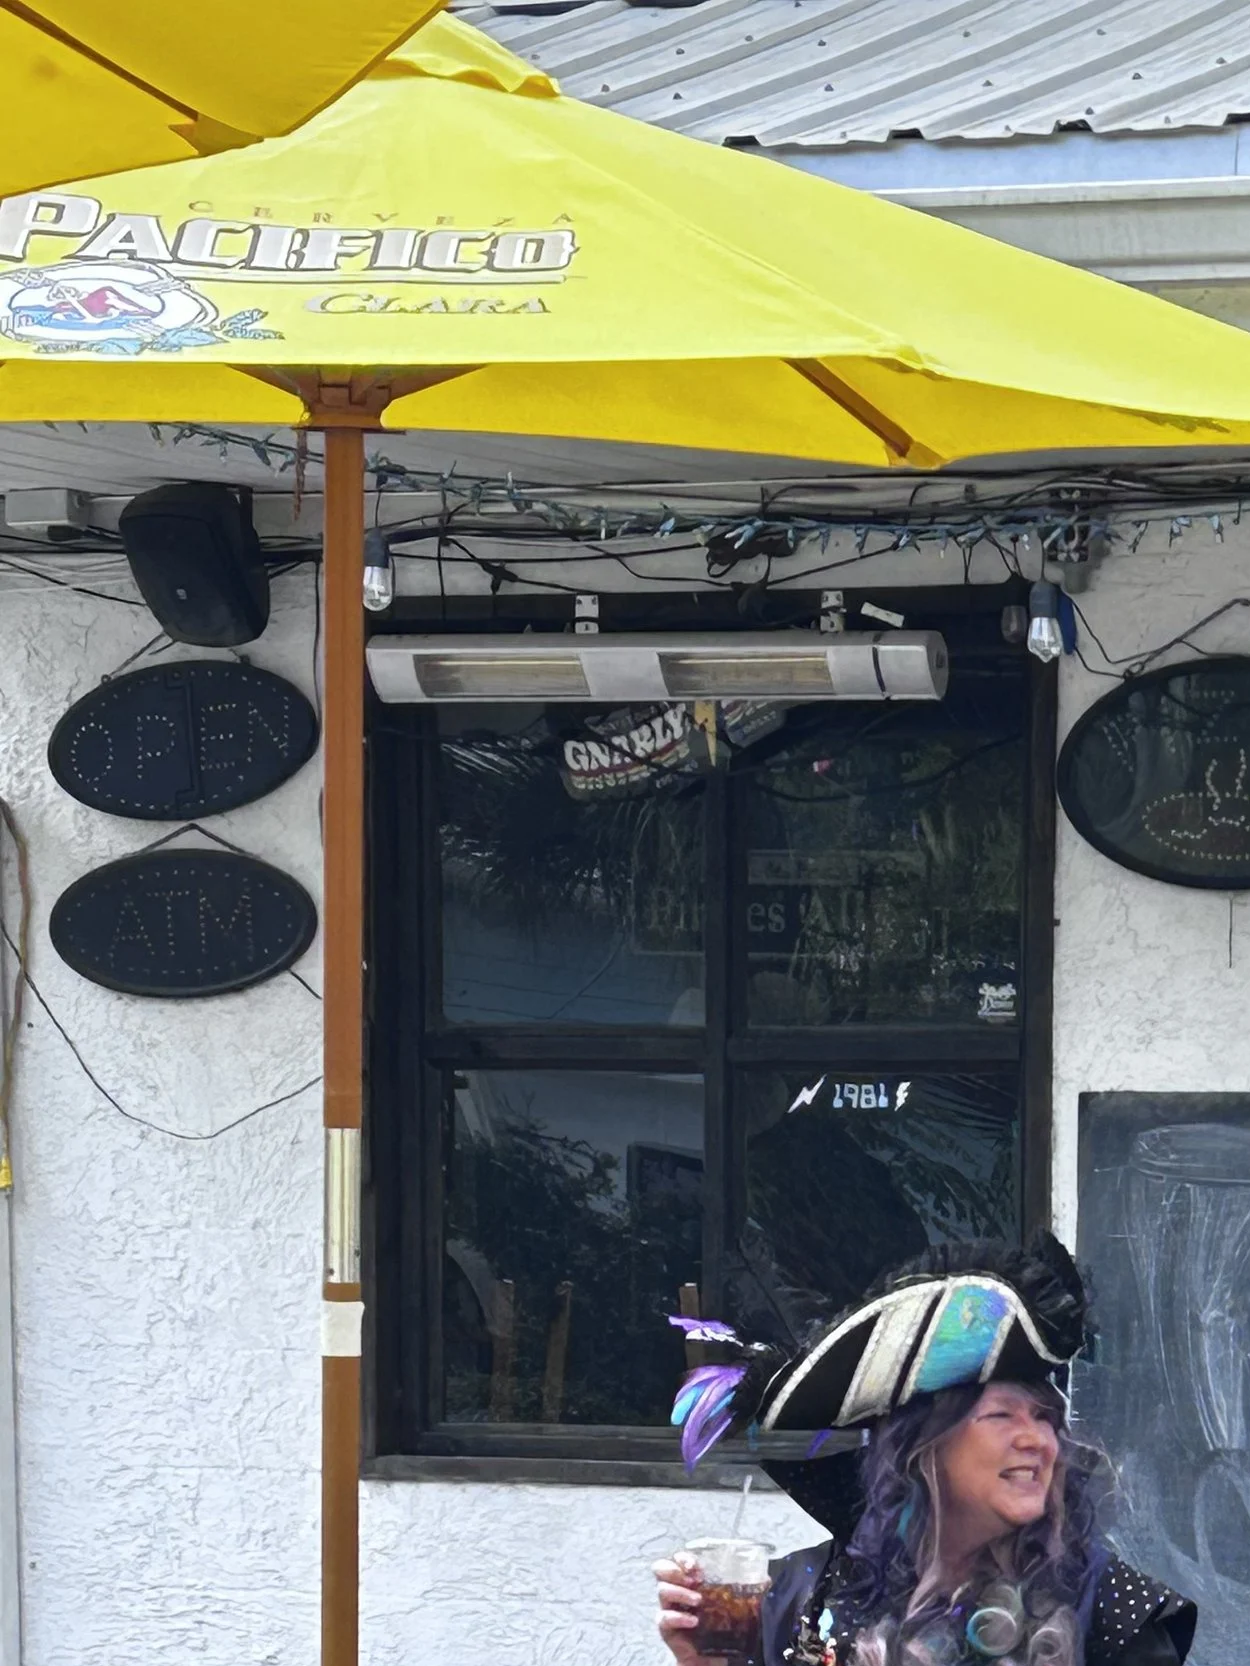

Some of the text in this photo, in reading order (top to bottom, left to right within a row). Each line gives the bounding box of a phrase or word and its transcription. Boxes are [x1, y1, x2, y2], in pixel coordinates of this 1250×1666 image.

[0, 193, 581, 272] PACIFICO
[71, 697, 290, 783] OPEN
[109, 888, 254, 962] ATM
[832, 1083, 889, 1109] 1981
